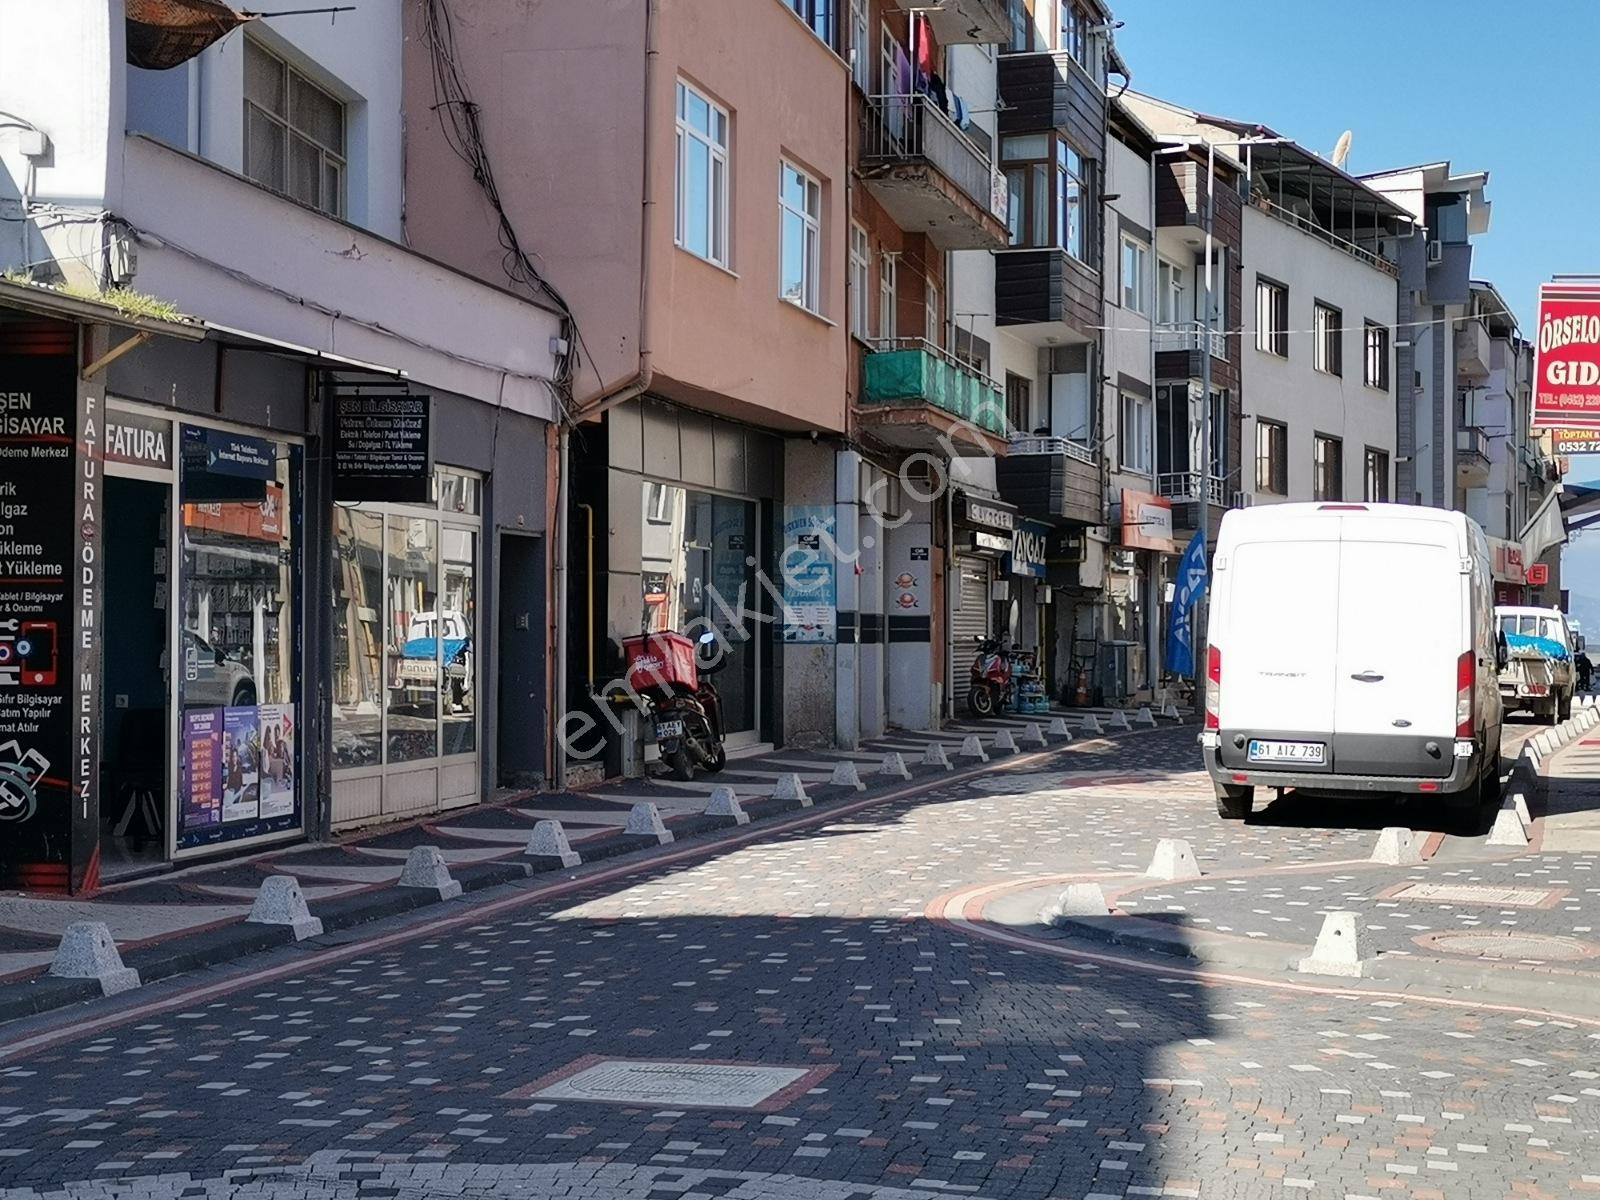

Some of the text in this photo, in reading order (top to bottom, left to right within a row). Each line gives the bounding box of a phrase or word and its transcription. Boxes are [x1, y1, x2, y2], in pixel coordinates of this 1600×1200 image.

[1546, 360, 1600, 386] GID
[0, 413, 65, 434] İSAYAR
[105, 423, 166, 462] FATURA
[1559, 441, 1587, 452] 0532
[0, 446, 69, 458] deme Merkezi
[5, 560, 63, 575] Yükleme
[0, 591, 19, 601] ablet
[80, 397, 96, 819] FATURA ÖDEME MERKEZİ
[17, 693, 62, 707] Bilgisayar
[0, 706, 51, 720] atım Yapılır
[17, 721, 39, 732] Atılır
[1258, 744, 1322, 758] 61 AIZ 739
